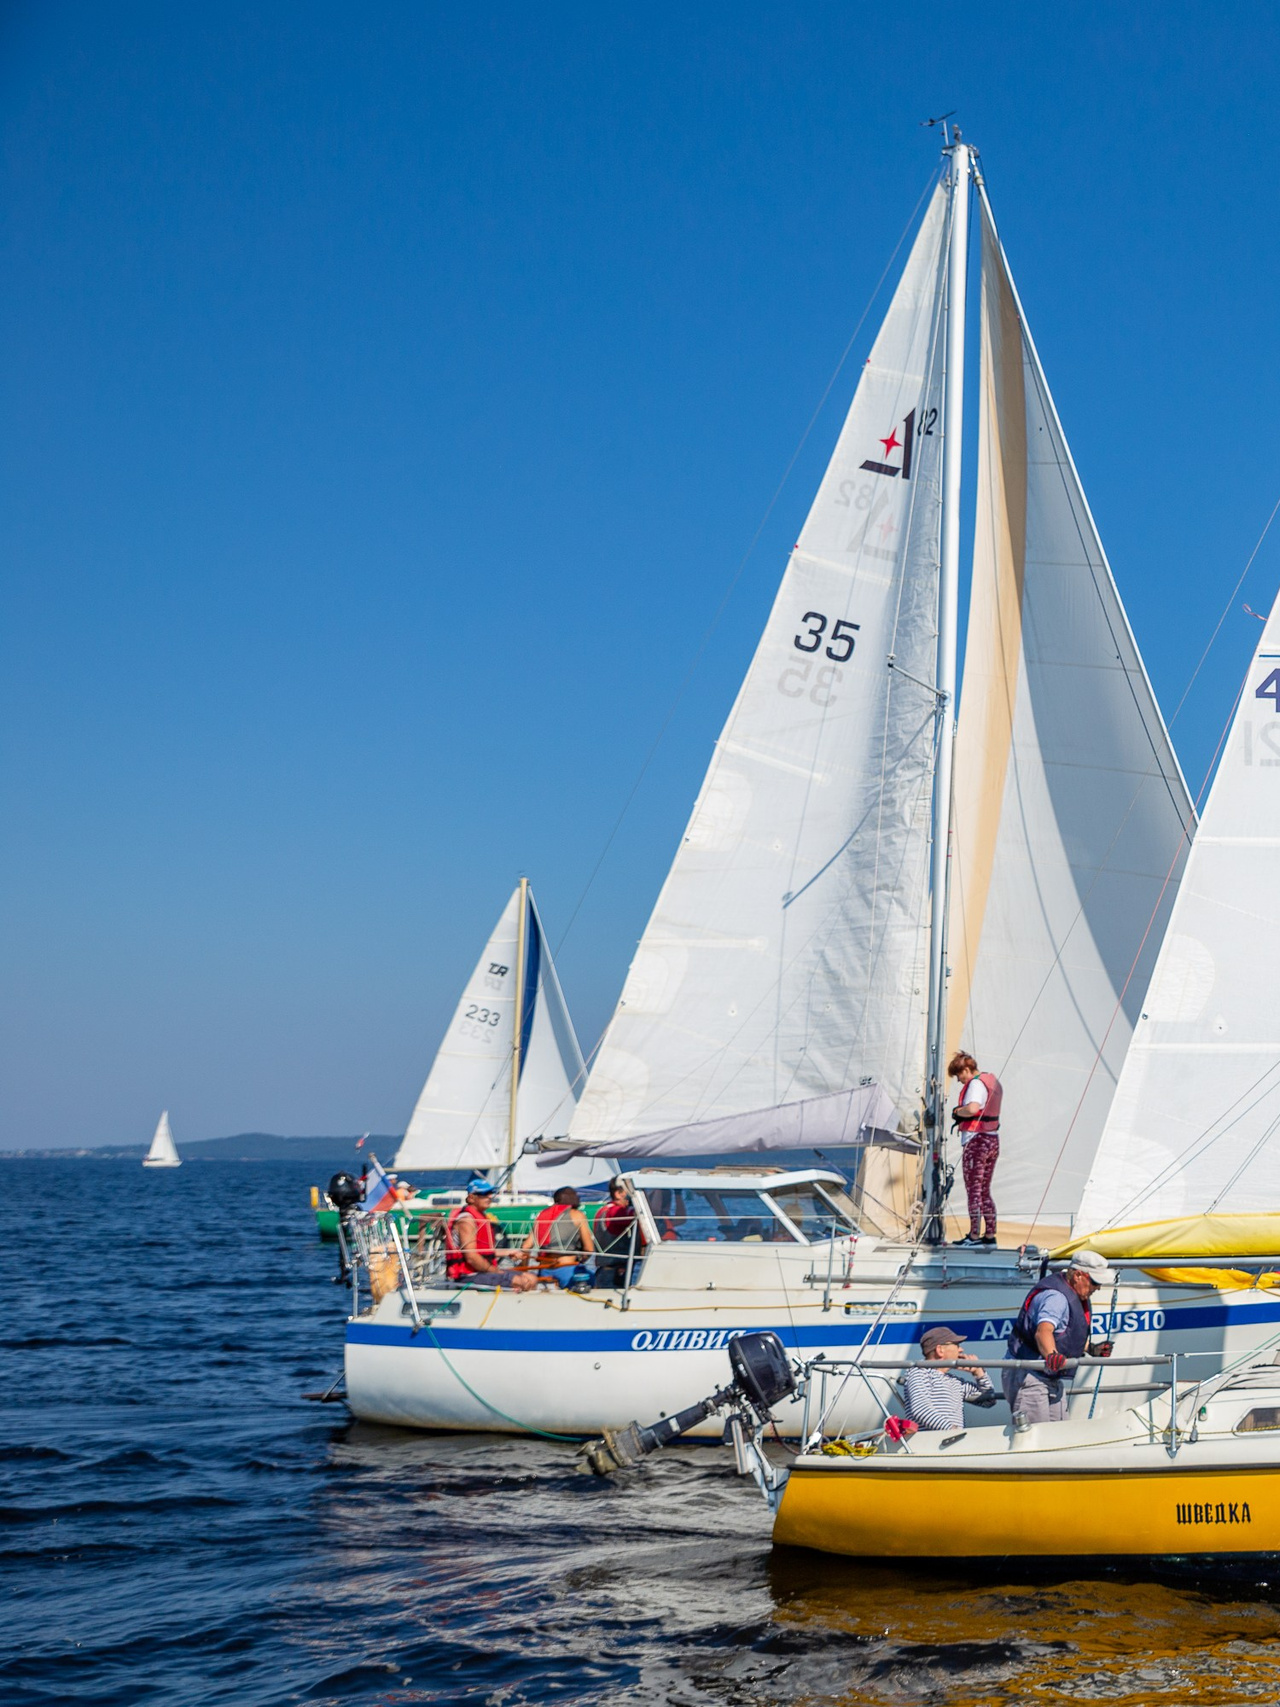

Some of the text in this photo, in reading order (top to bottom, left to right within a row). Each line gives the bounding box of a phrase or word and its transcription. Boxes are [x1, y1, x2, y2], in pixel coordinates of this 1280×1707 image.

[794, 610, 861, 663] 35
[465, 1003, 501, 1027] 233
[1091, 1310, 1166, 1334] RUS10
[1176, 1501, 1251, 1525] ШВЕДКА
